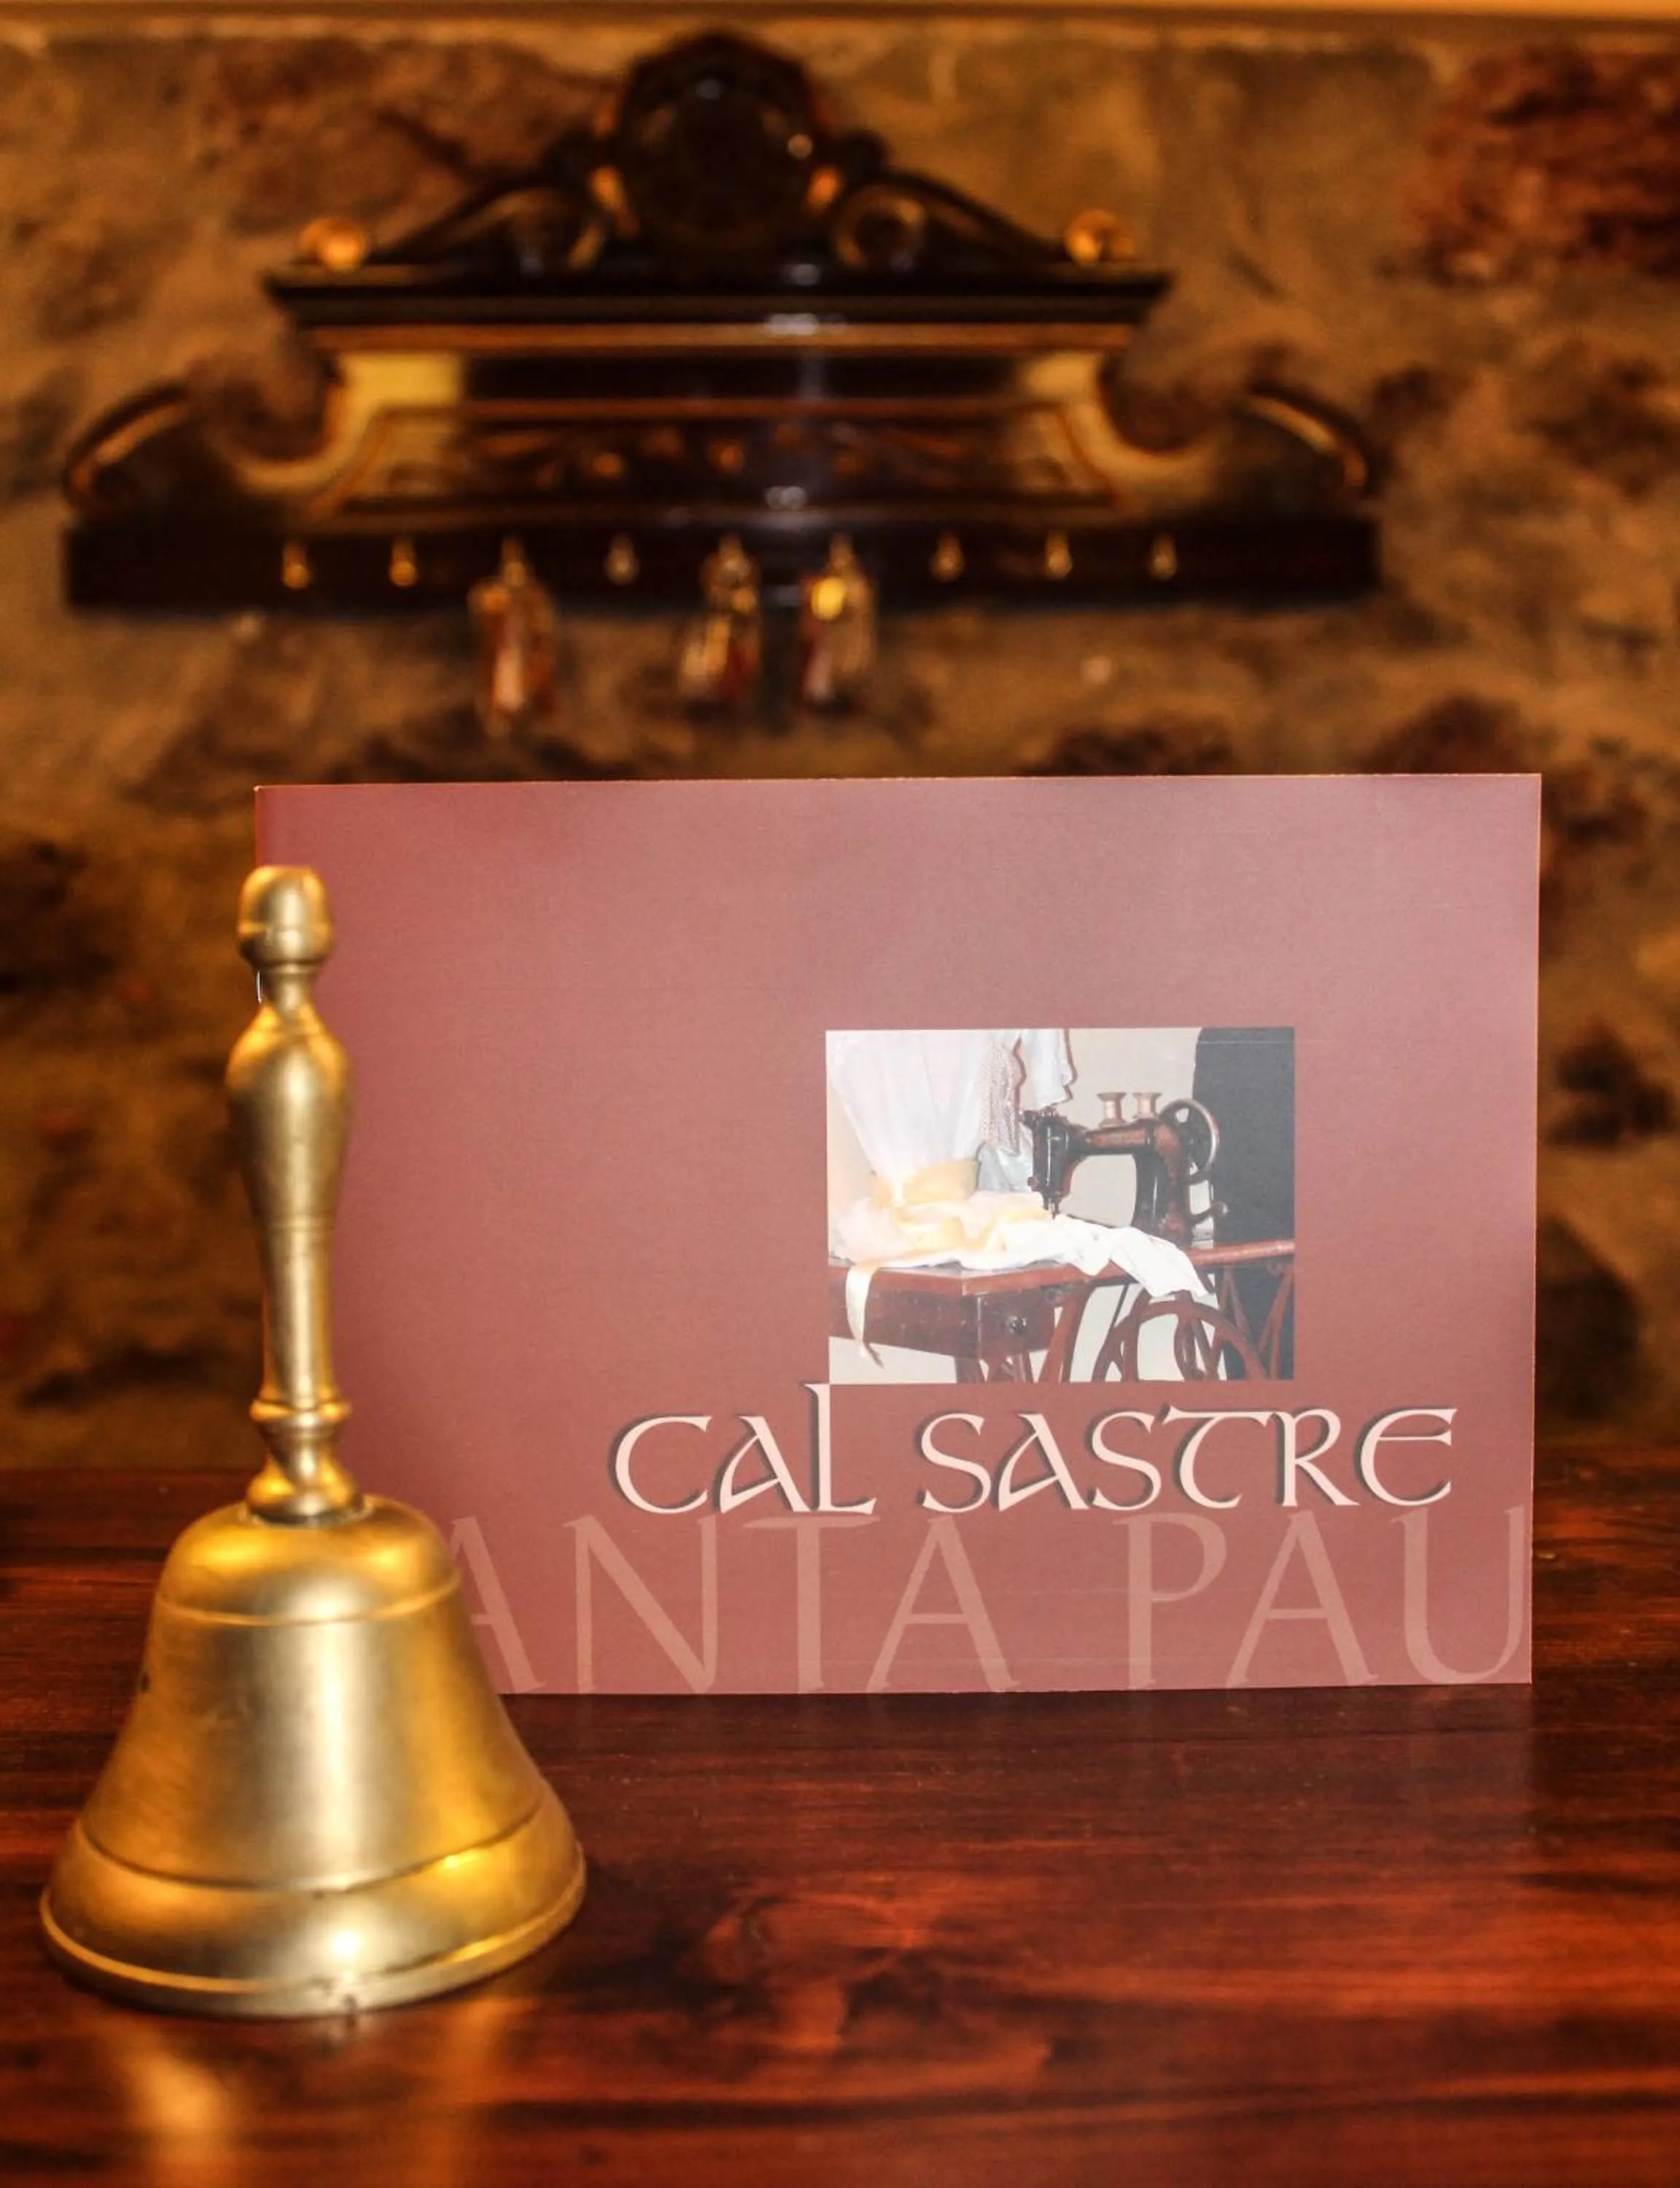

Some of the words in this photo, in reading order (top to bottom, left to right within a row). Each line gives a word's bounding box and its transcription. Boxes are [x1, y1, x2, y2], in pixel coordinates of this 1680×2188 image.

[612, 1383, 877, 1515] CAL
[919, 1405, 1458, 1513] SASTRE
[1112, 1506, 1525, 1690] PAU
